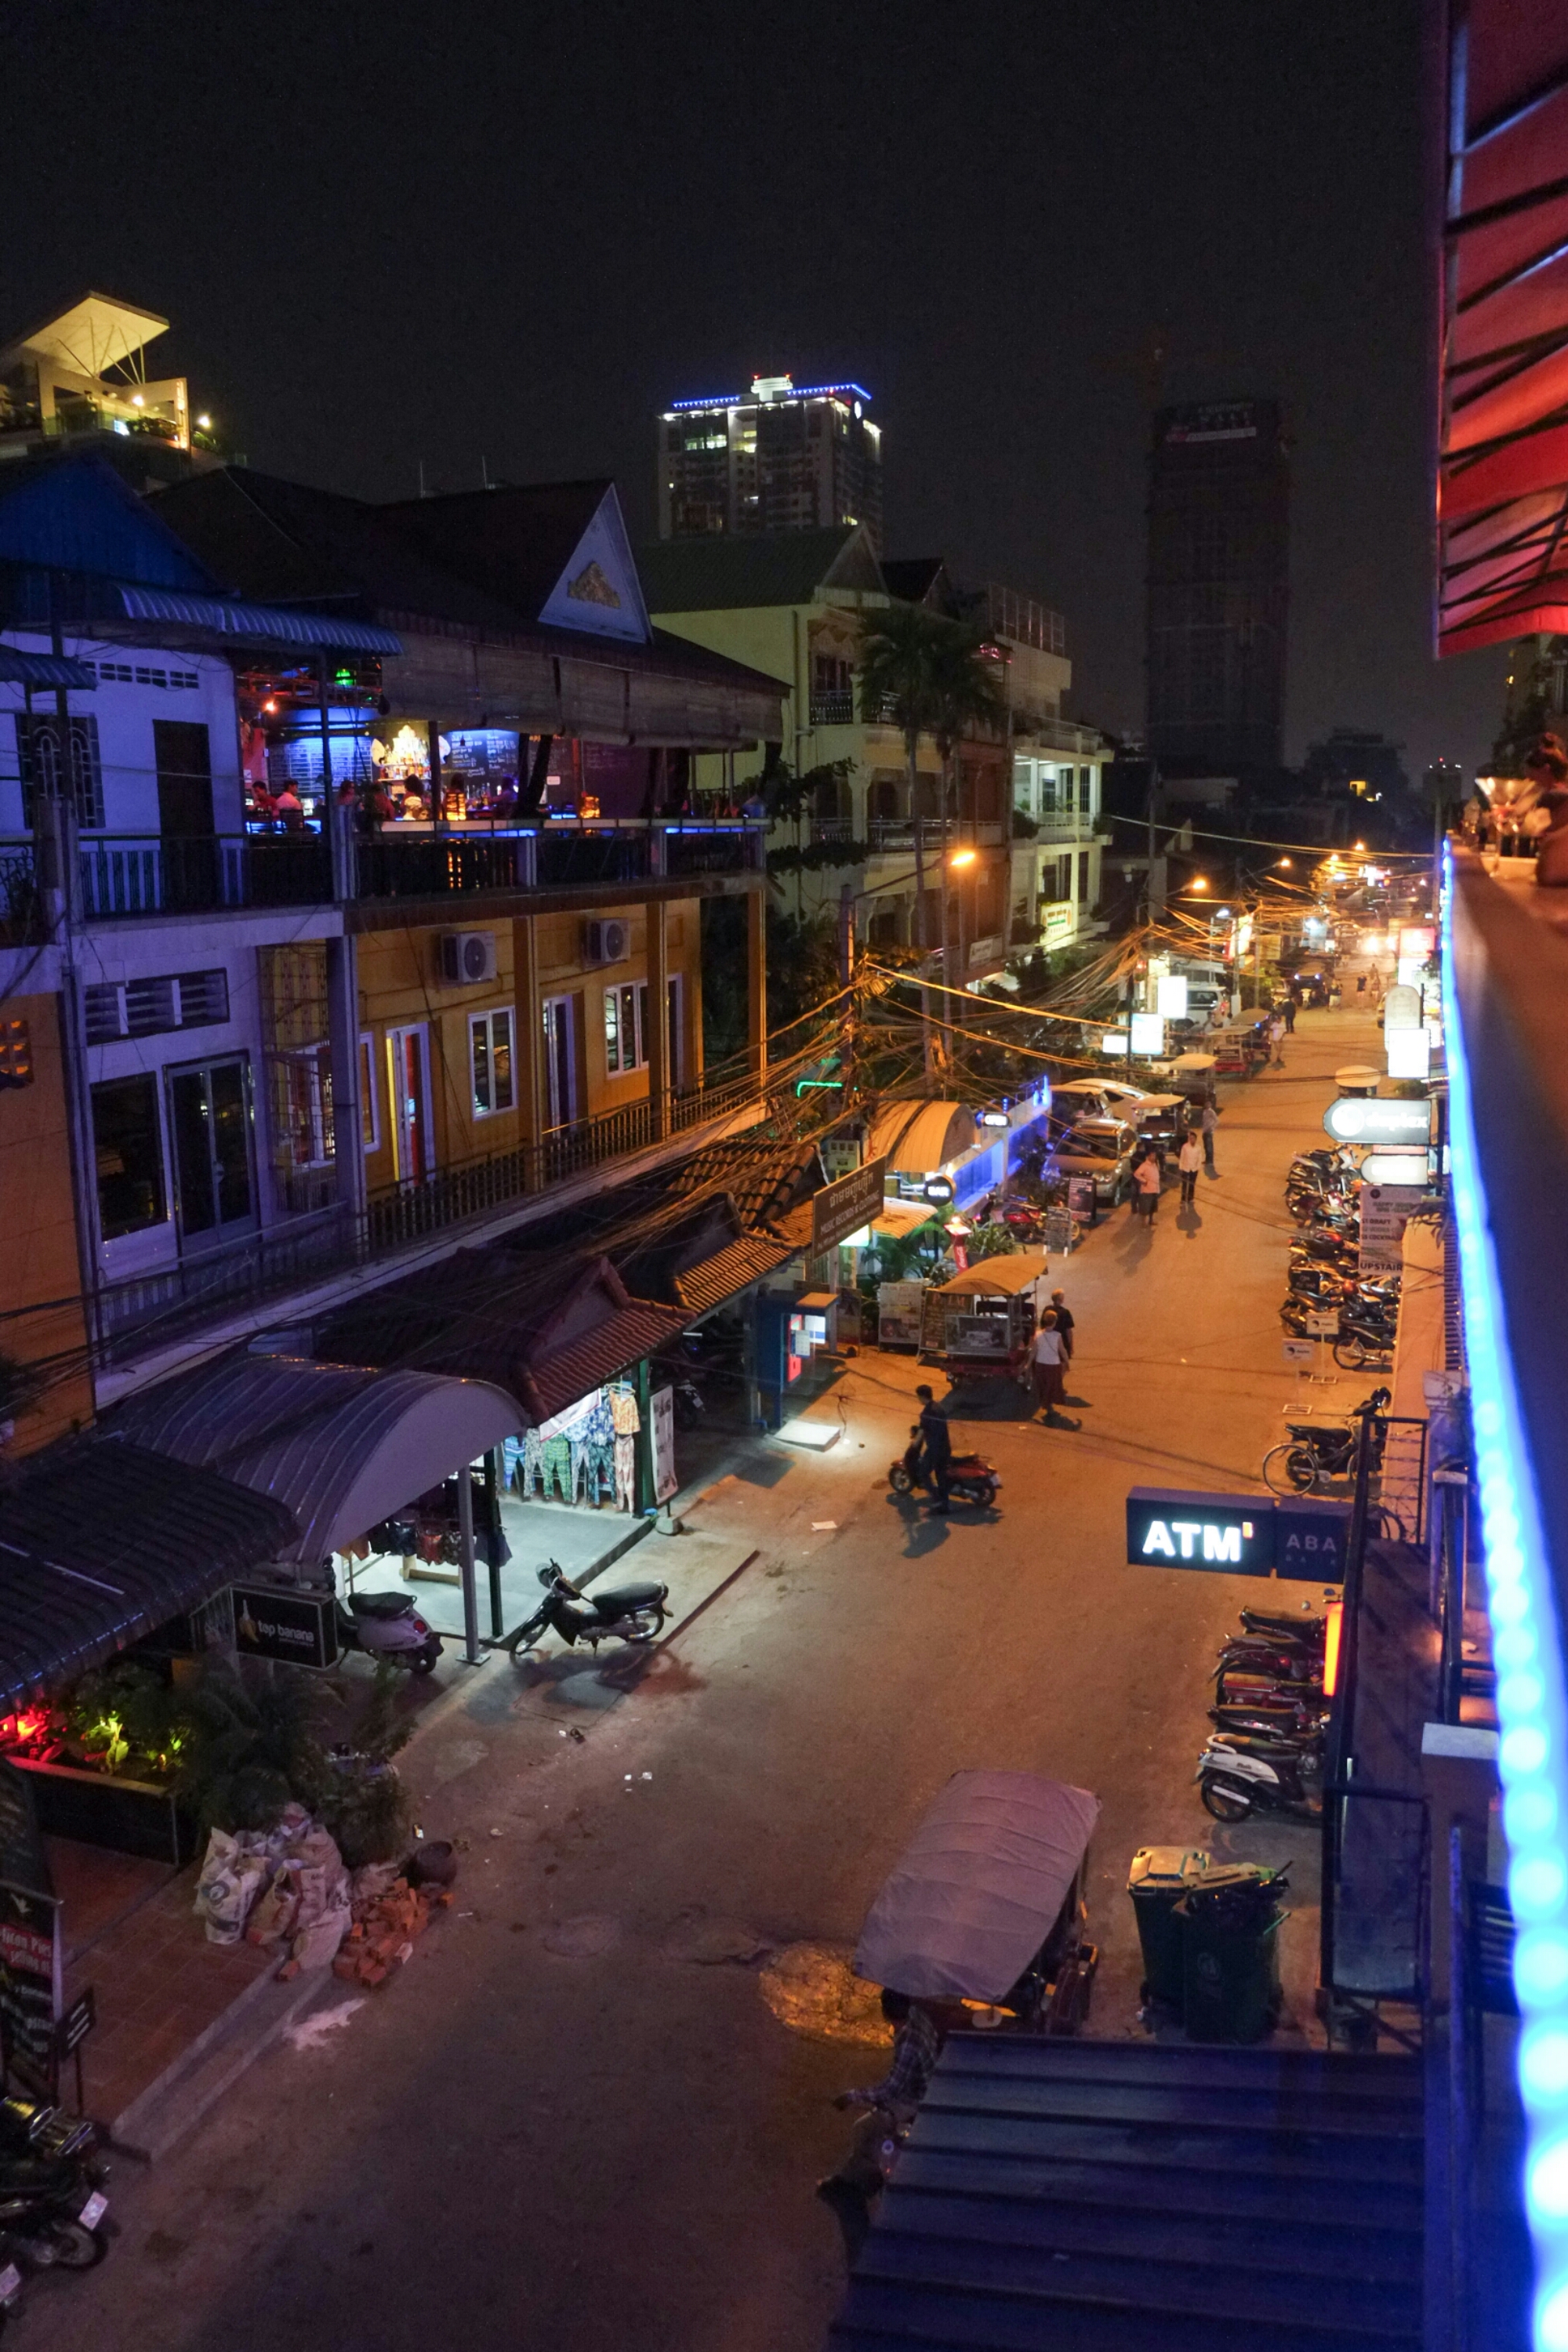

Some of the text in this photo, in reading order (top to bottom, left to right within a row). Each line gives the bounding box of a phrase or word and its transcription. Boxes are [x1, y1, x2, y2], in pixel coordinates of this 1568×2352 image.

[1366, 1112, 1427, 1131] duplex
[1142, 1520, 1337, 1562] ATM ABA
[257, 1620, 275, 1636] top
[278, 1624, 314, 1642] banana
